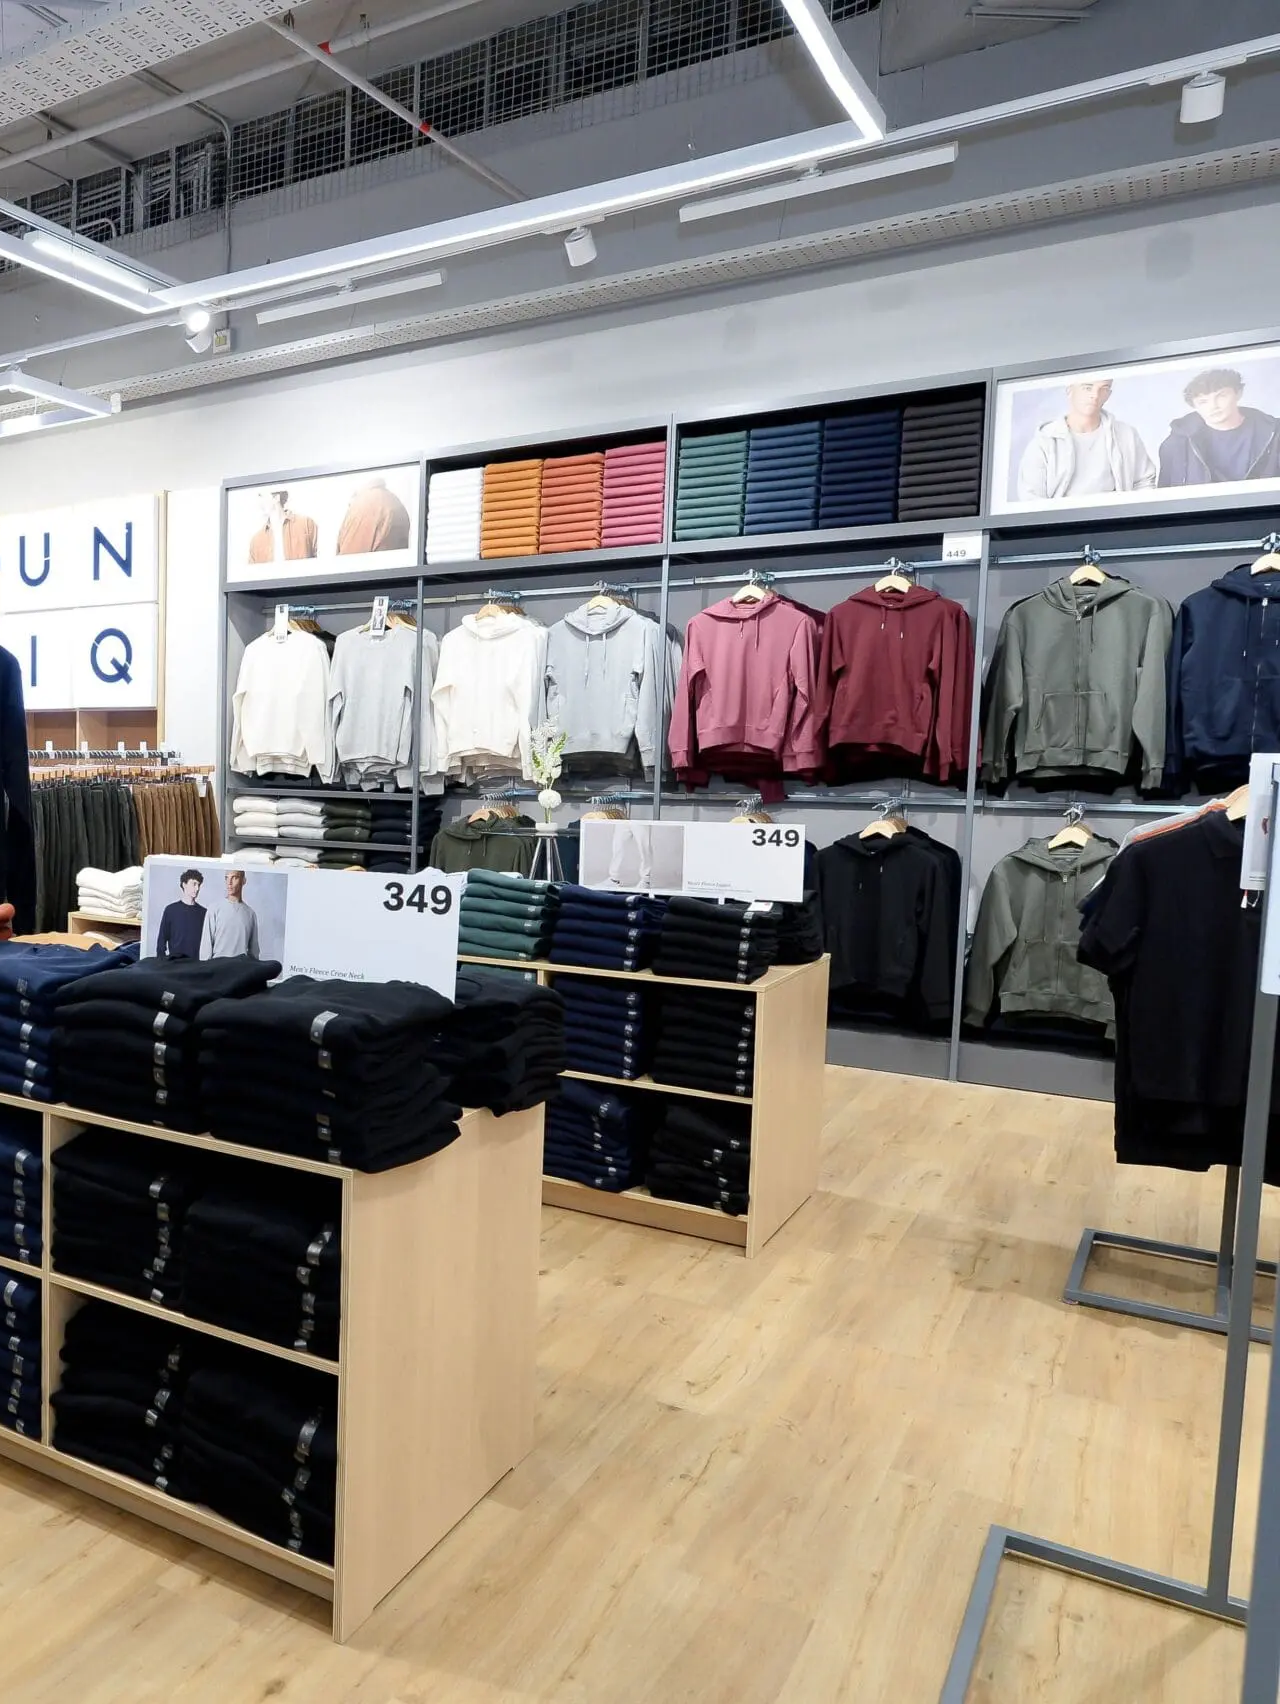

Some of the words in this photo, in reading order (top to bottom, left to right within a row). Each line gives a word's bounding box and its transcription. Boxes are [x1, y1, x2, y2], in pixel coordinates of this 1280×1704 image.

[946, 549, 967, 558] 449
[751, 828, 800, 847] 349
[383, 882, 452, 915] 349
[290, 965, 308, 973] Men's
[309, 967, 329, 976] Fleece
[330, 969, 347, 978] Crew
[348, 971, 365, 980] Neck
